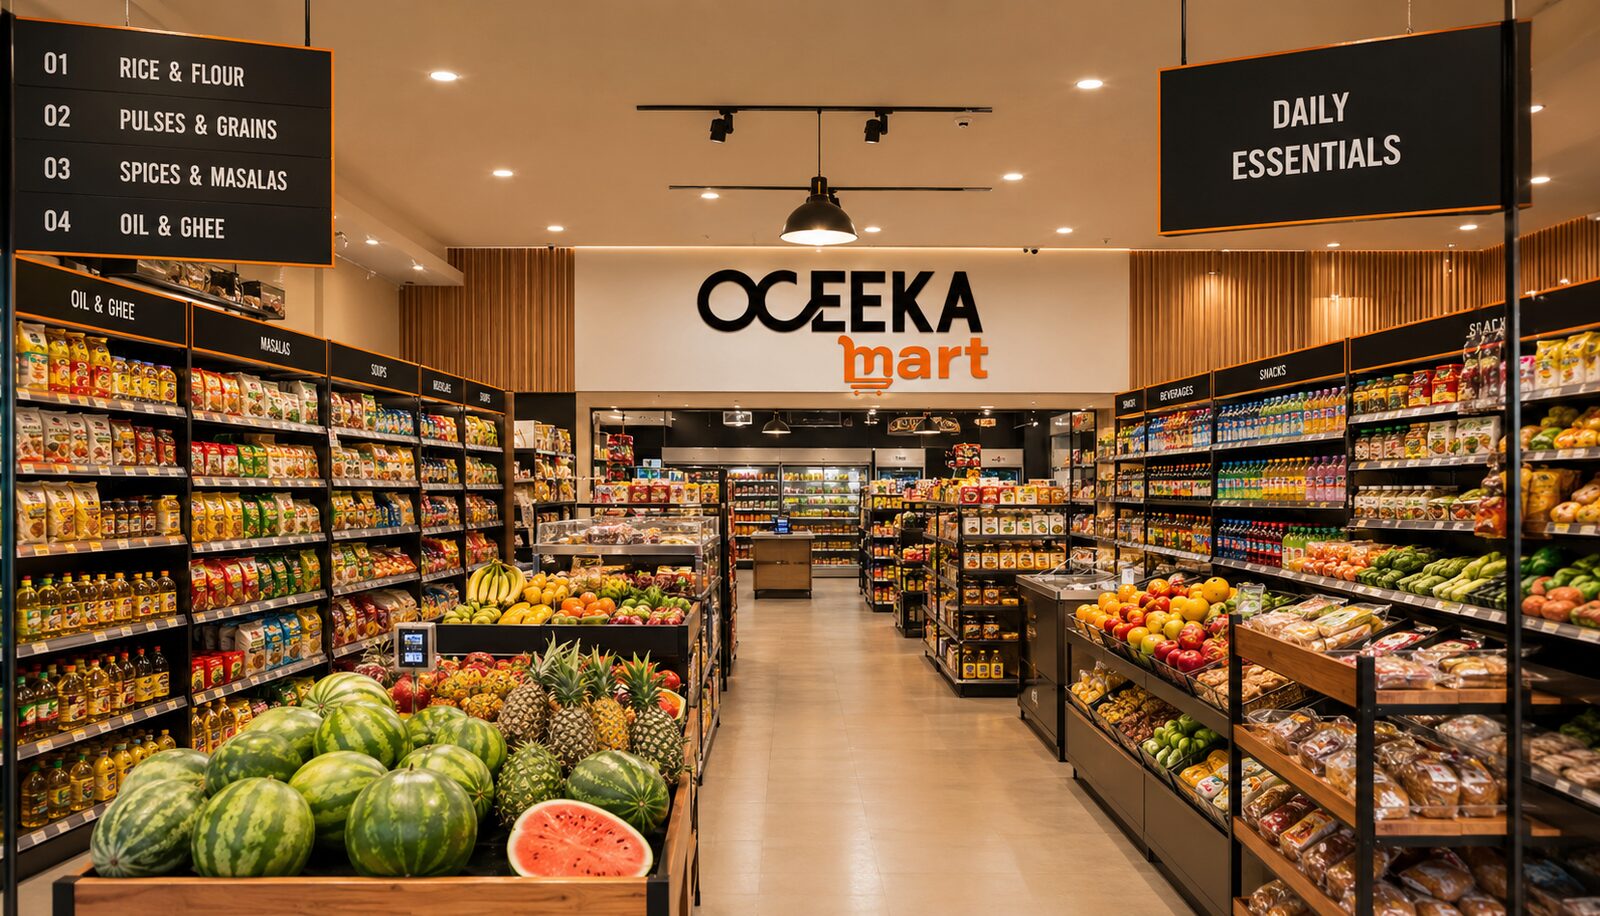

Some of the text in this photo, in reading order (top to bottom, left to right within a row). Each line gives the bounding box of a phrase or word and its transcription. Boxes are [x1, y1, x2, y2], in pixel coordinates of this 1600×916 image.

[44, 51, 245, 88] 01 RICE & FLOUR
[44, 103, 278, 140] 02 PULSES & GRAINS
[1273, 91, 1350, 129] DAILY
[44, 156, 288, 191] 03 SPICES & MASALAS
[1232, 134, 1401, 181] ESSENTIALS
[44, 209, 225, 239] 04 OIL & GHEE
[71, 289, 135, 321] OIL & GHEE
[697, 269, 983, 333] OCEEKA
[260, 336, 292, 357] MASALAS
[838, 335, 988, 390] mart
[1259, 364, 1287, 381] SNACKS
[1159, 385, 1195, 402] BEVERAGES
